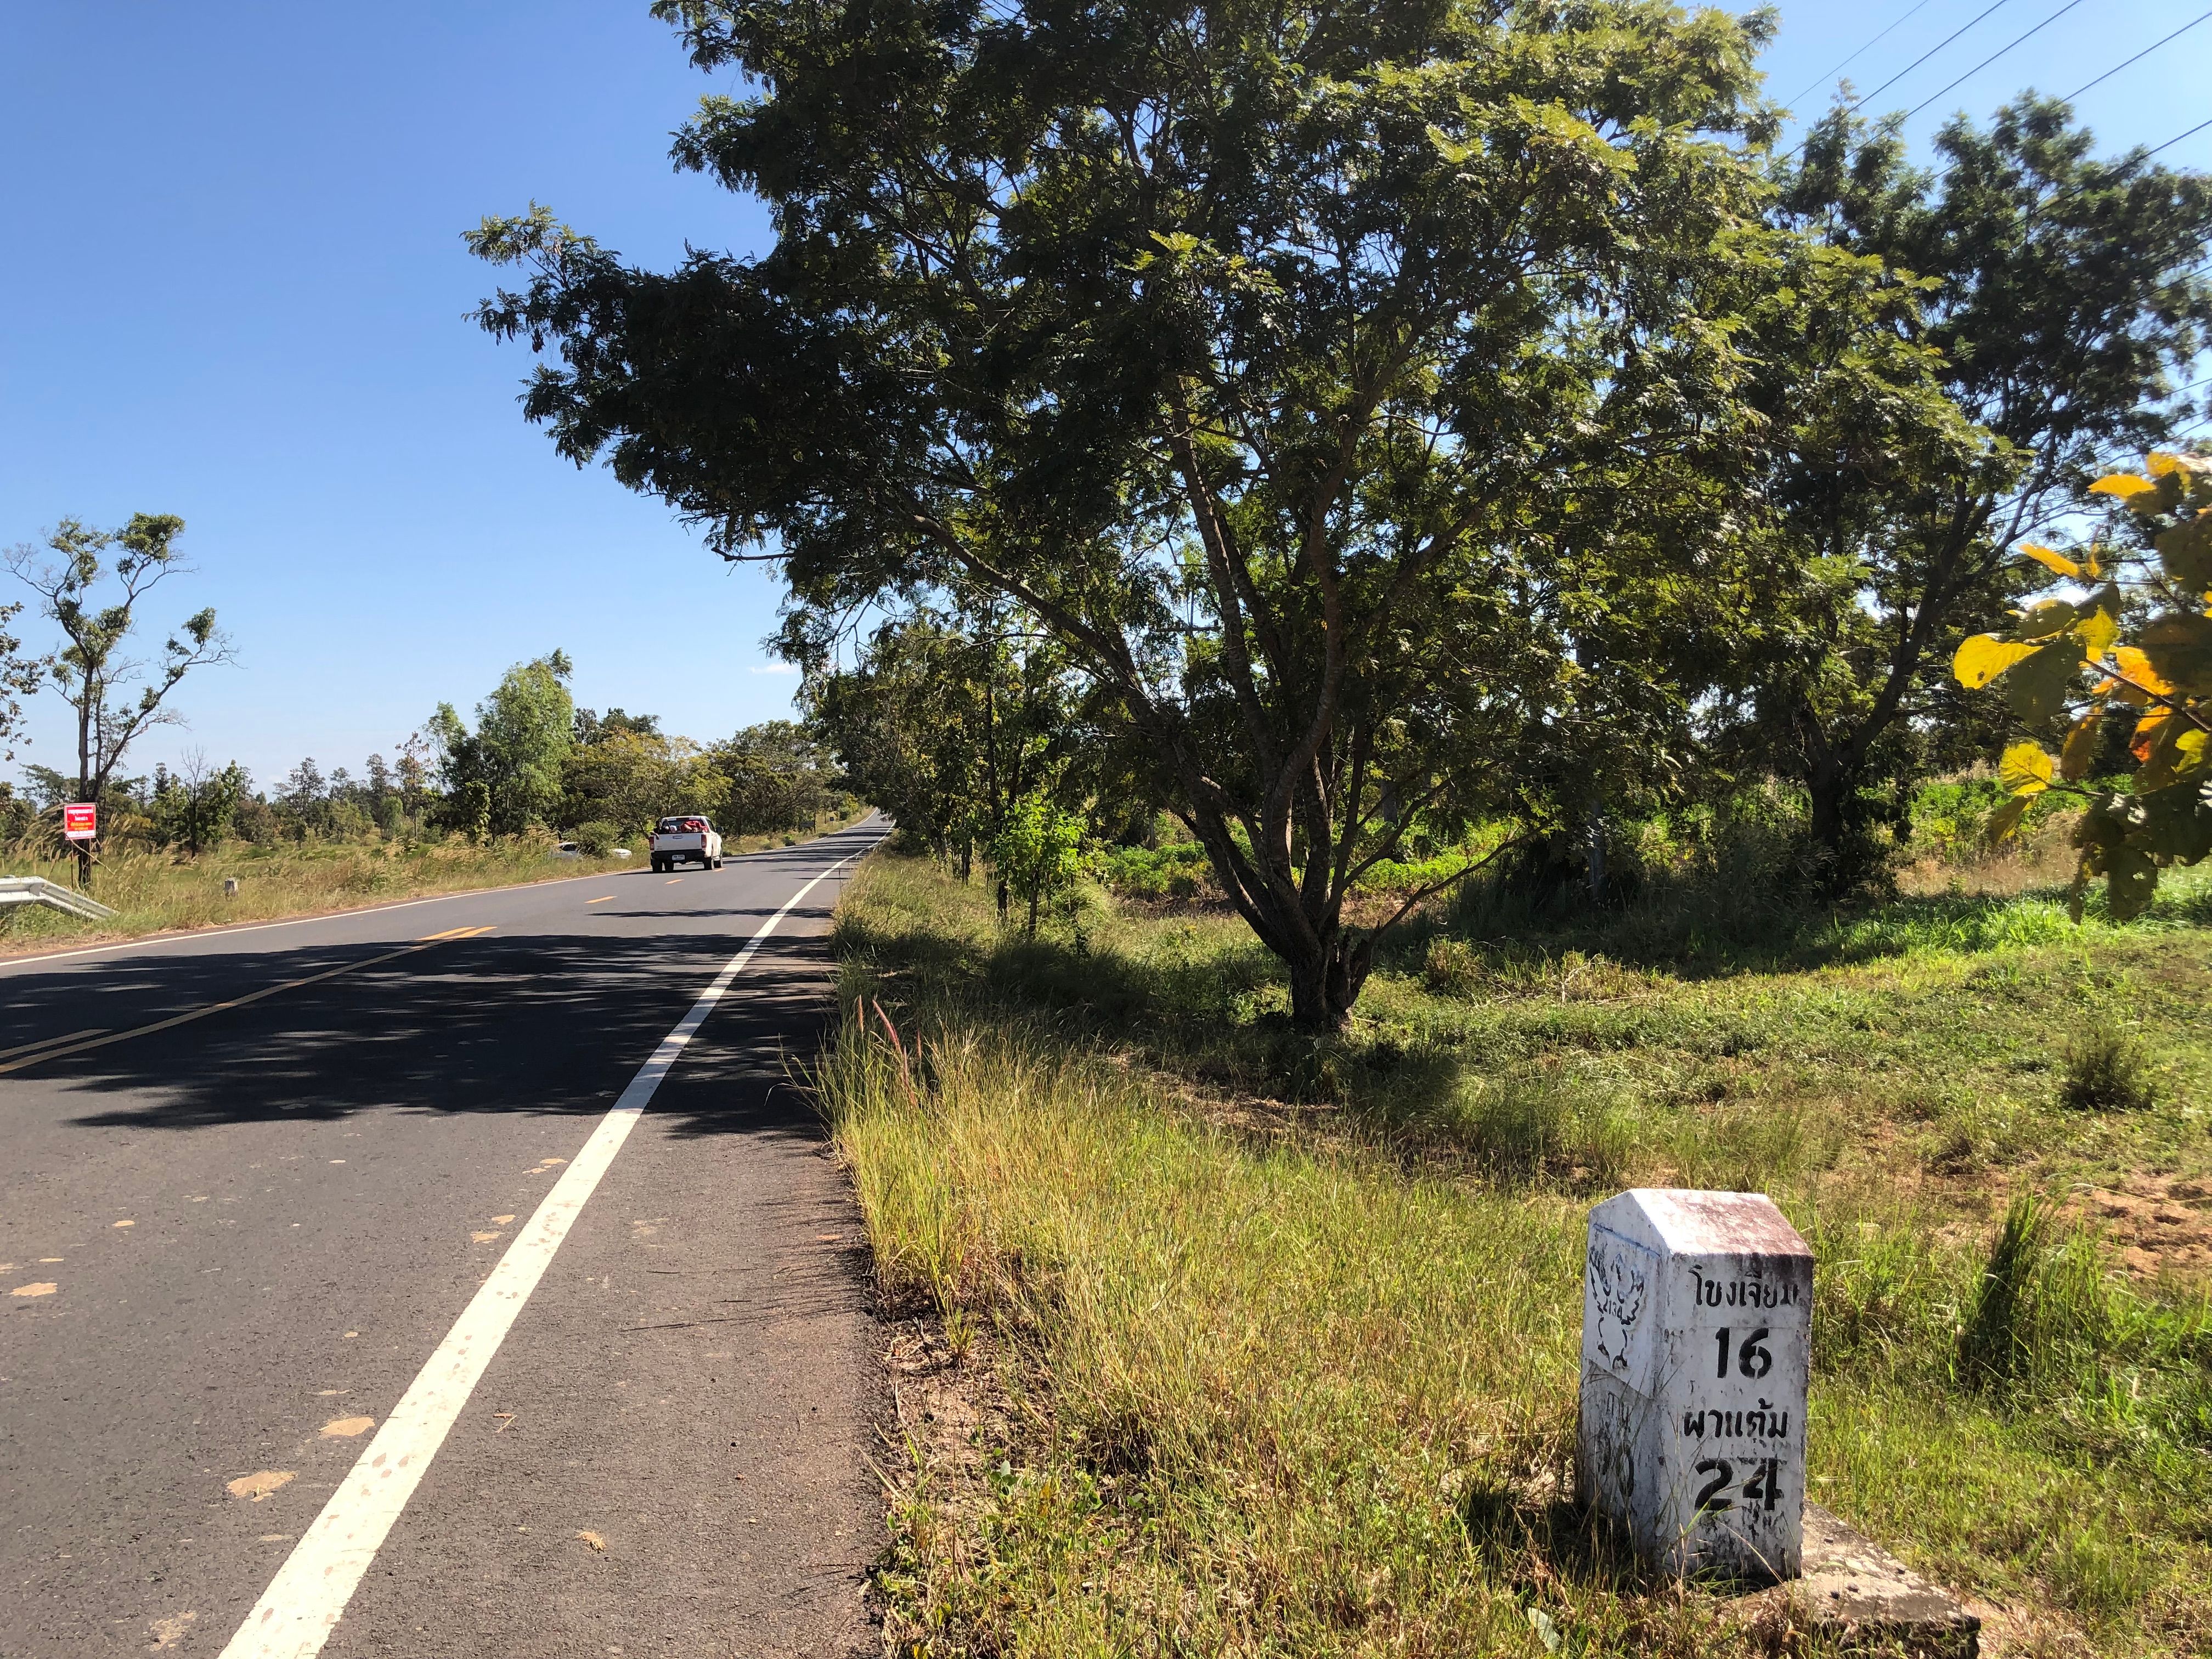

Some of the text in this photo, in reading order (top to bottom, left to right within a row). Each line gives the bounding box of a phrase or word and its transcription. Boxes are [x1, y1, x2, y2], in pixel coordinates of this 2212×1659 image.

[1688, 1264, 1799, 1308] โขงเจียม
[1715, 1327, 1773, 1380] 16
[1684, 1397, 1788, 1438] ผาแต้ม
[1694, 1457, 1784, 1511] 24
